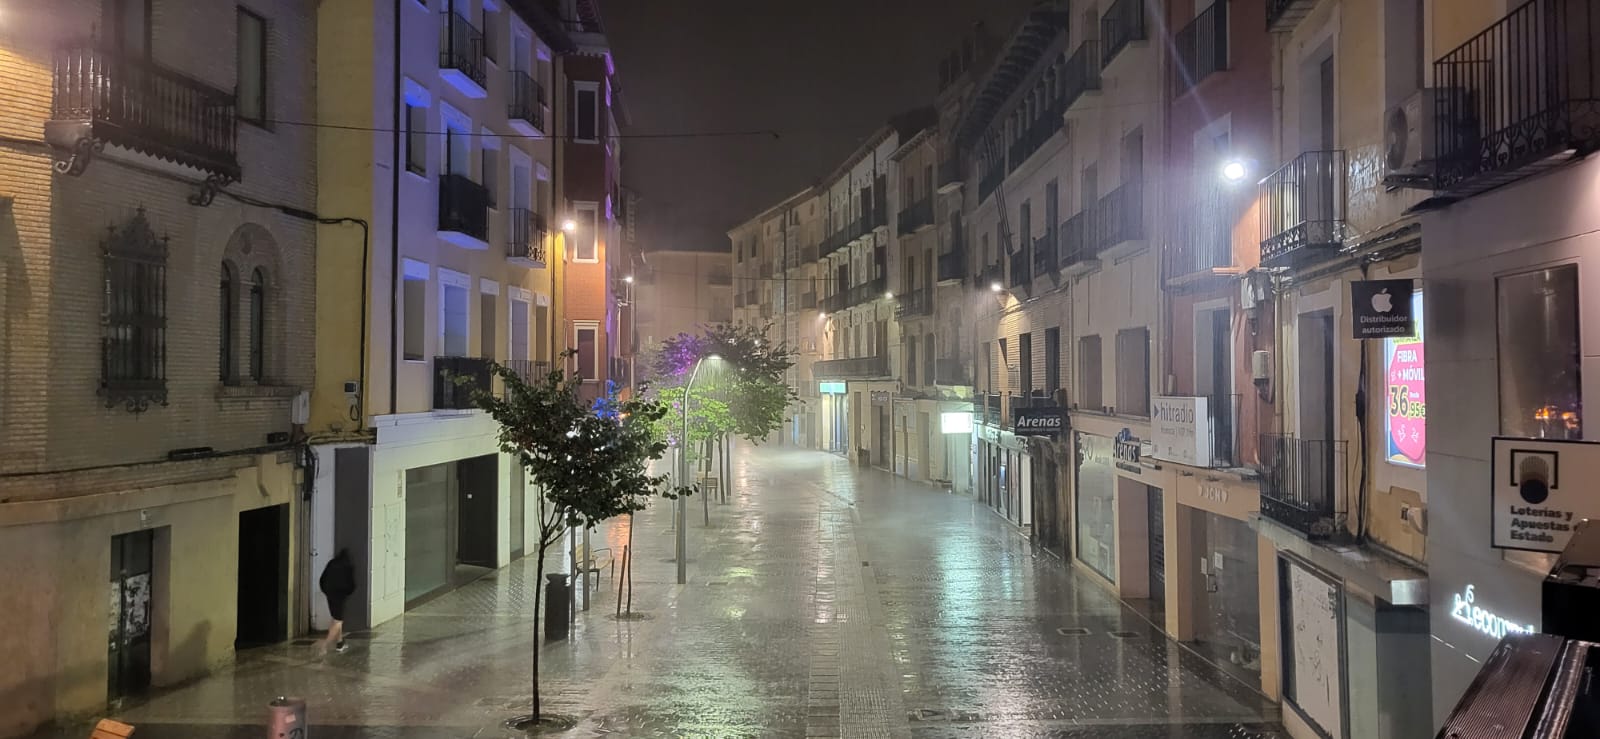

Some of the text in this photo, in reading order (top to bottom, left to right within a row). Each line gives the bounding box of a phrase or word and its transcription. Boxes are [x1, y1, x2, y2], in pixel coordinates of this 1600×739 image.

[1360, 314, 1408, 323] Distribuidor
[1362, 326, 1405, 334] autorizado
[1397, 350, 1418, 363] FIBRA
[1160, 401, 1194, 424] hitradio
[1017, 415, 1061, 428] Arenas
[1510, 505, 1573, 522] Loterías y
[1511, 518, 1569, 531] Apuestas
[1511, 530, 1554, 543] Estado
